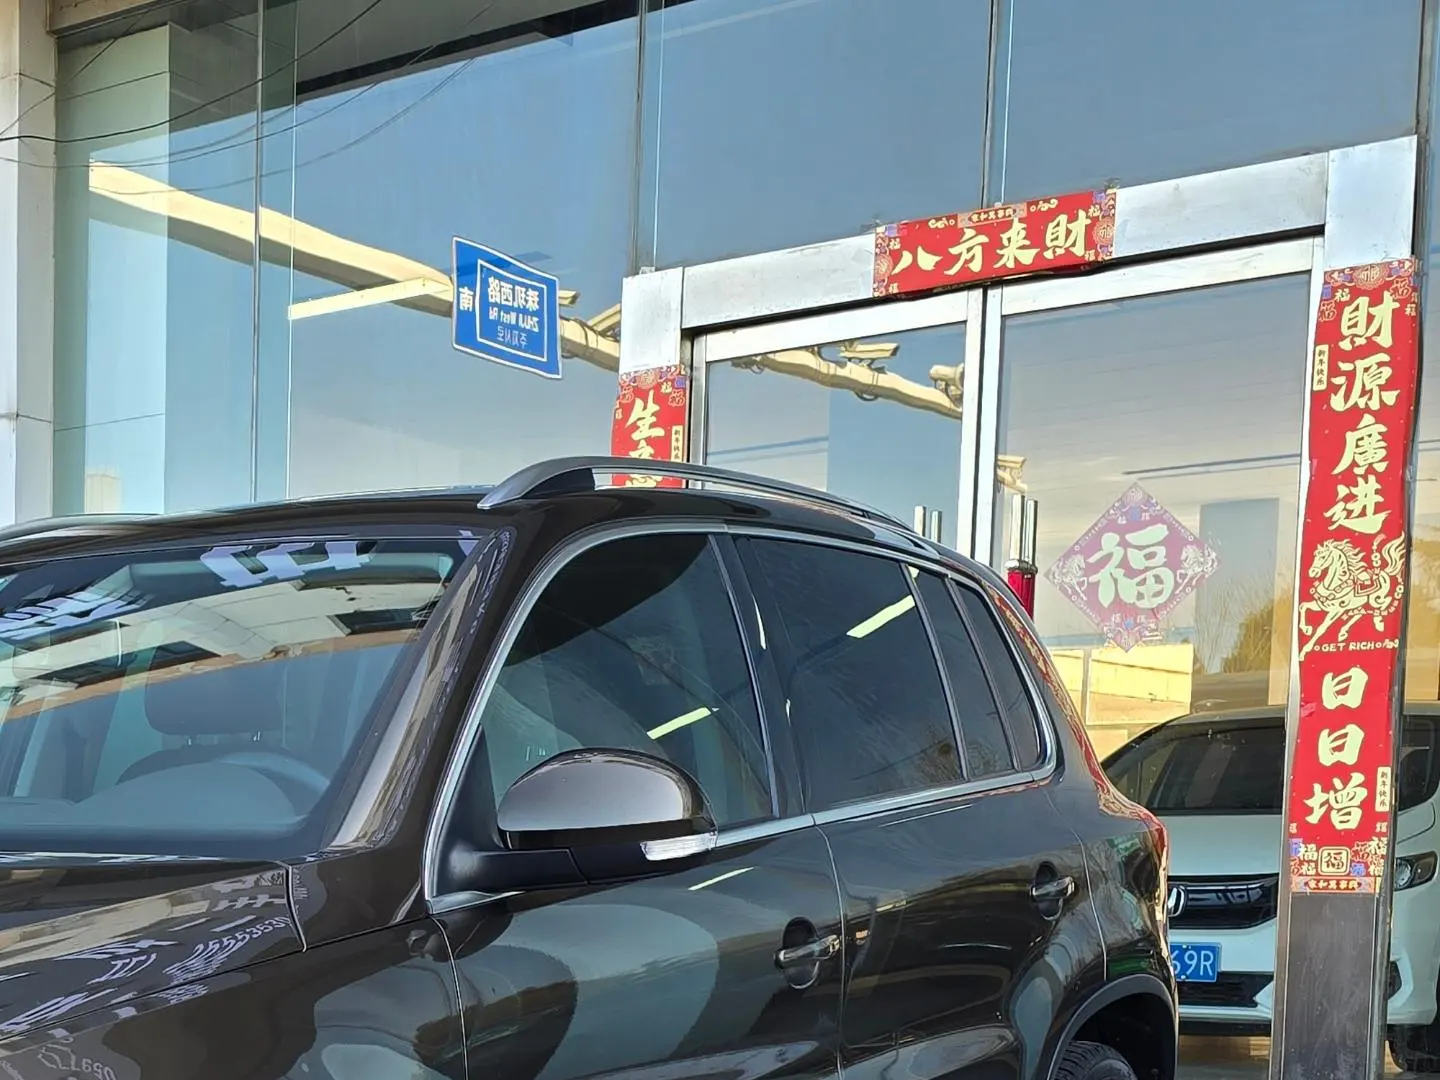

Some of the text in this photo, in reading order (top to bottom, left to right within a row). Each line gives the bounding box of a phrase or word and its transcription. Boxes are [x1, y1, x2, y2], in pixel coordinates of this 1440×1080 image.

[1086, 523, 1175, 609] 福
[1321, 640, 1374, 652] GET RICH
[1323, 851, 1345, 870] 福
